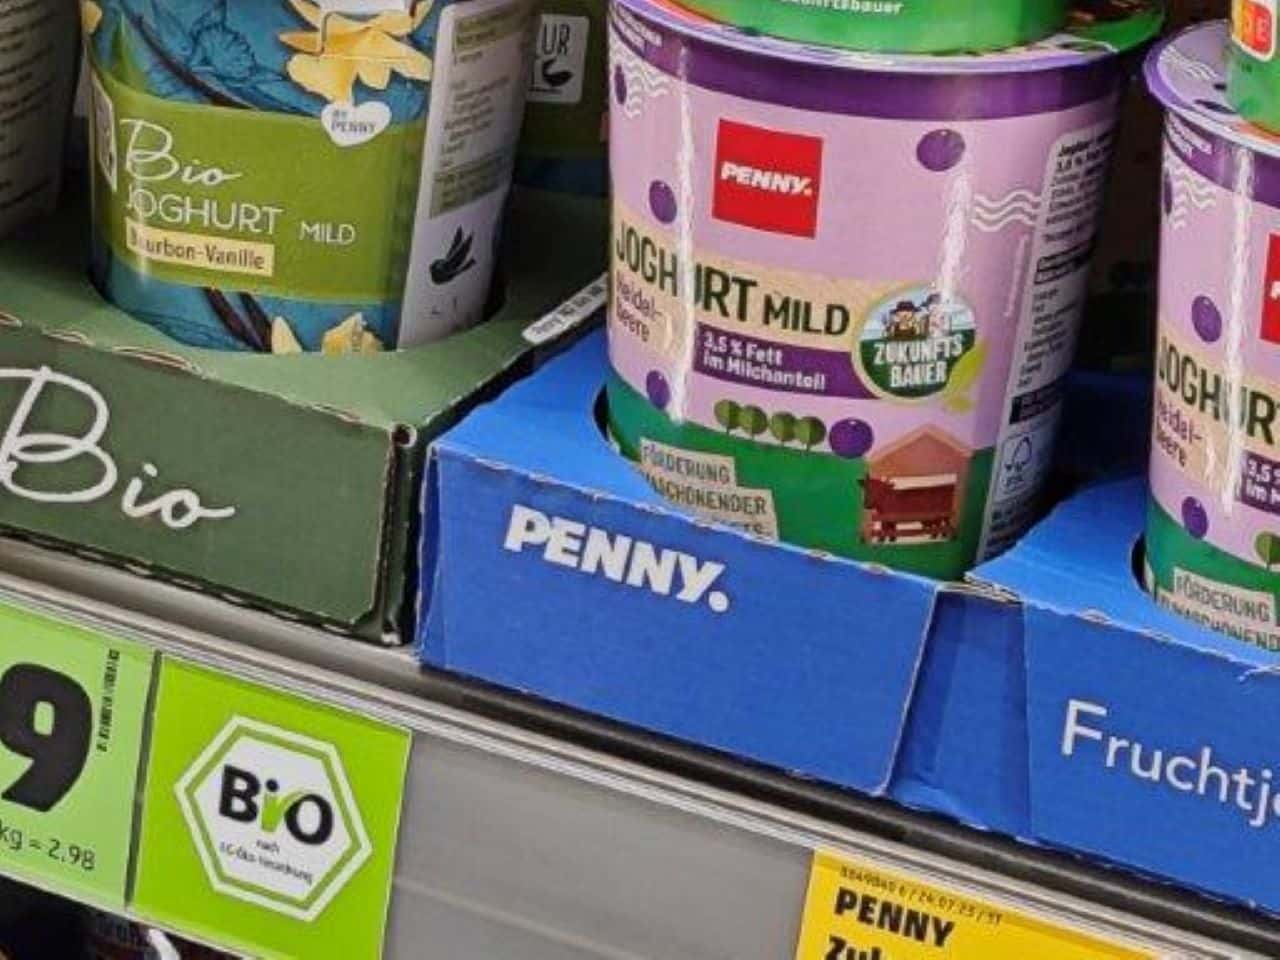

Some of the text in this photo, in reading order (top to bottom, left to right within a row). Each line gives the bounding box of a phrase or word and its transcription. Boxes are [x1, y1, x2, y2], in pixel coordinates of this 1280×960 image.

[120, 118, 242, 187] Bio
[721, 161, 812, 196] PENNY.
[128, 184, 356, 245] JOGHURT MILD
[763, 294, 850, 336] MILD
[727, 356, 826, 391] Milchanteil
[873, 335, 963, 364] ZUKUNFTS
[890, 361, 947, 389] BAUER
[503, 504, 732, 615] PENNY.
[1061, 699, 1280, 827] Fruchtj
[0, 821, 23, 851] kg
[48, 839, 96, 872] 2.98
[834, 886, 955, 947] PENNY
